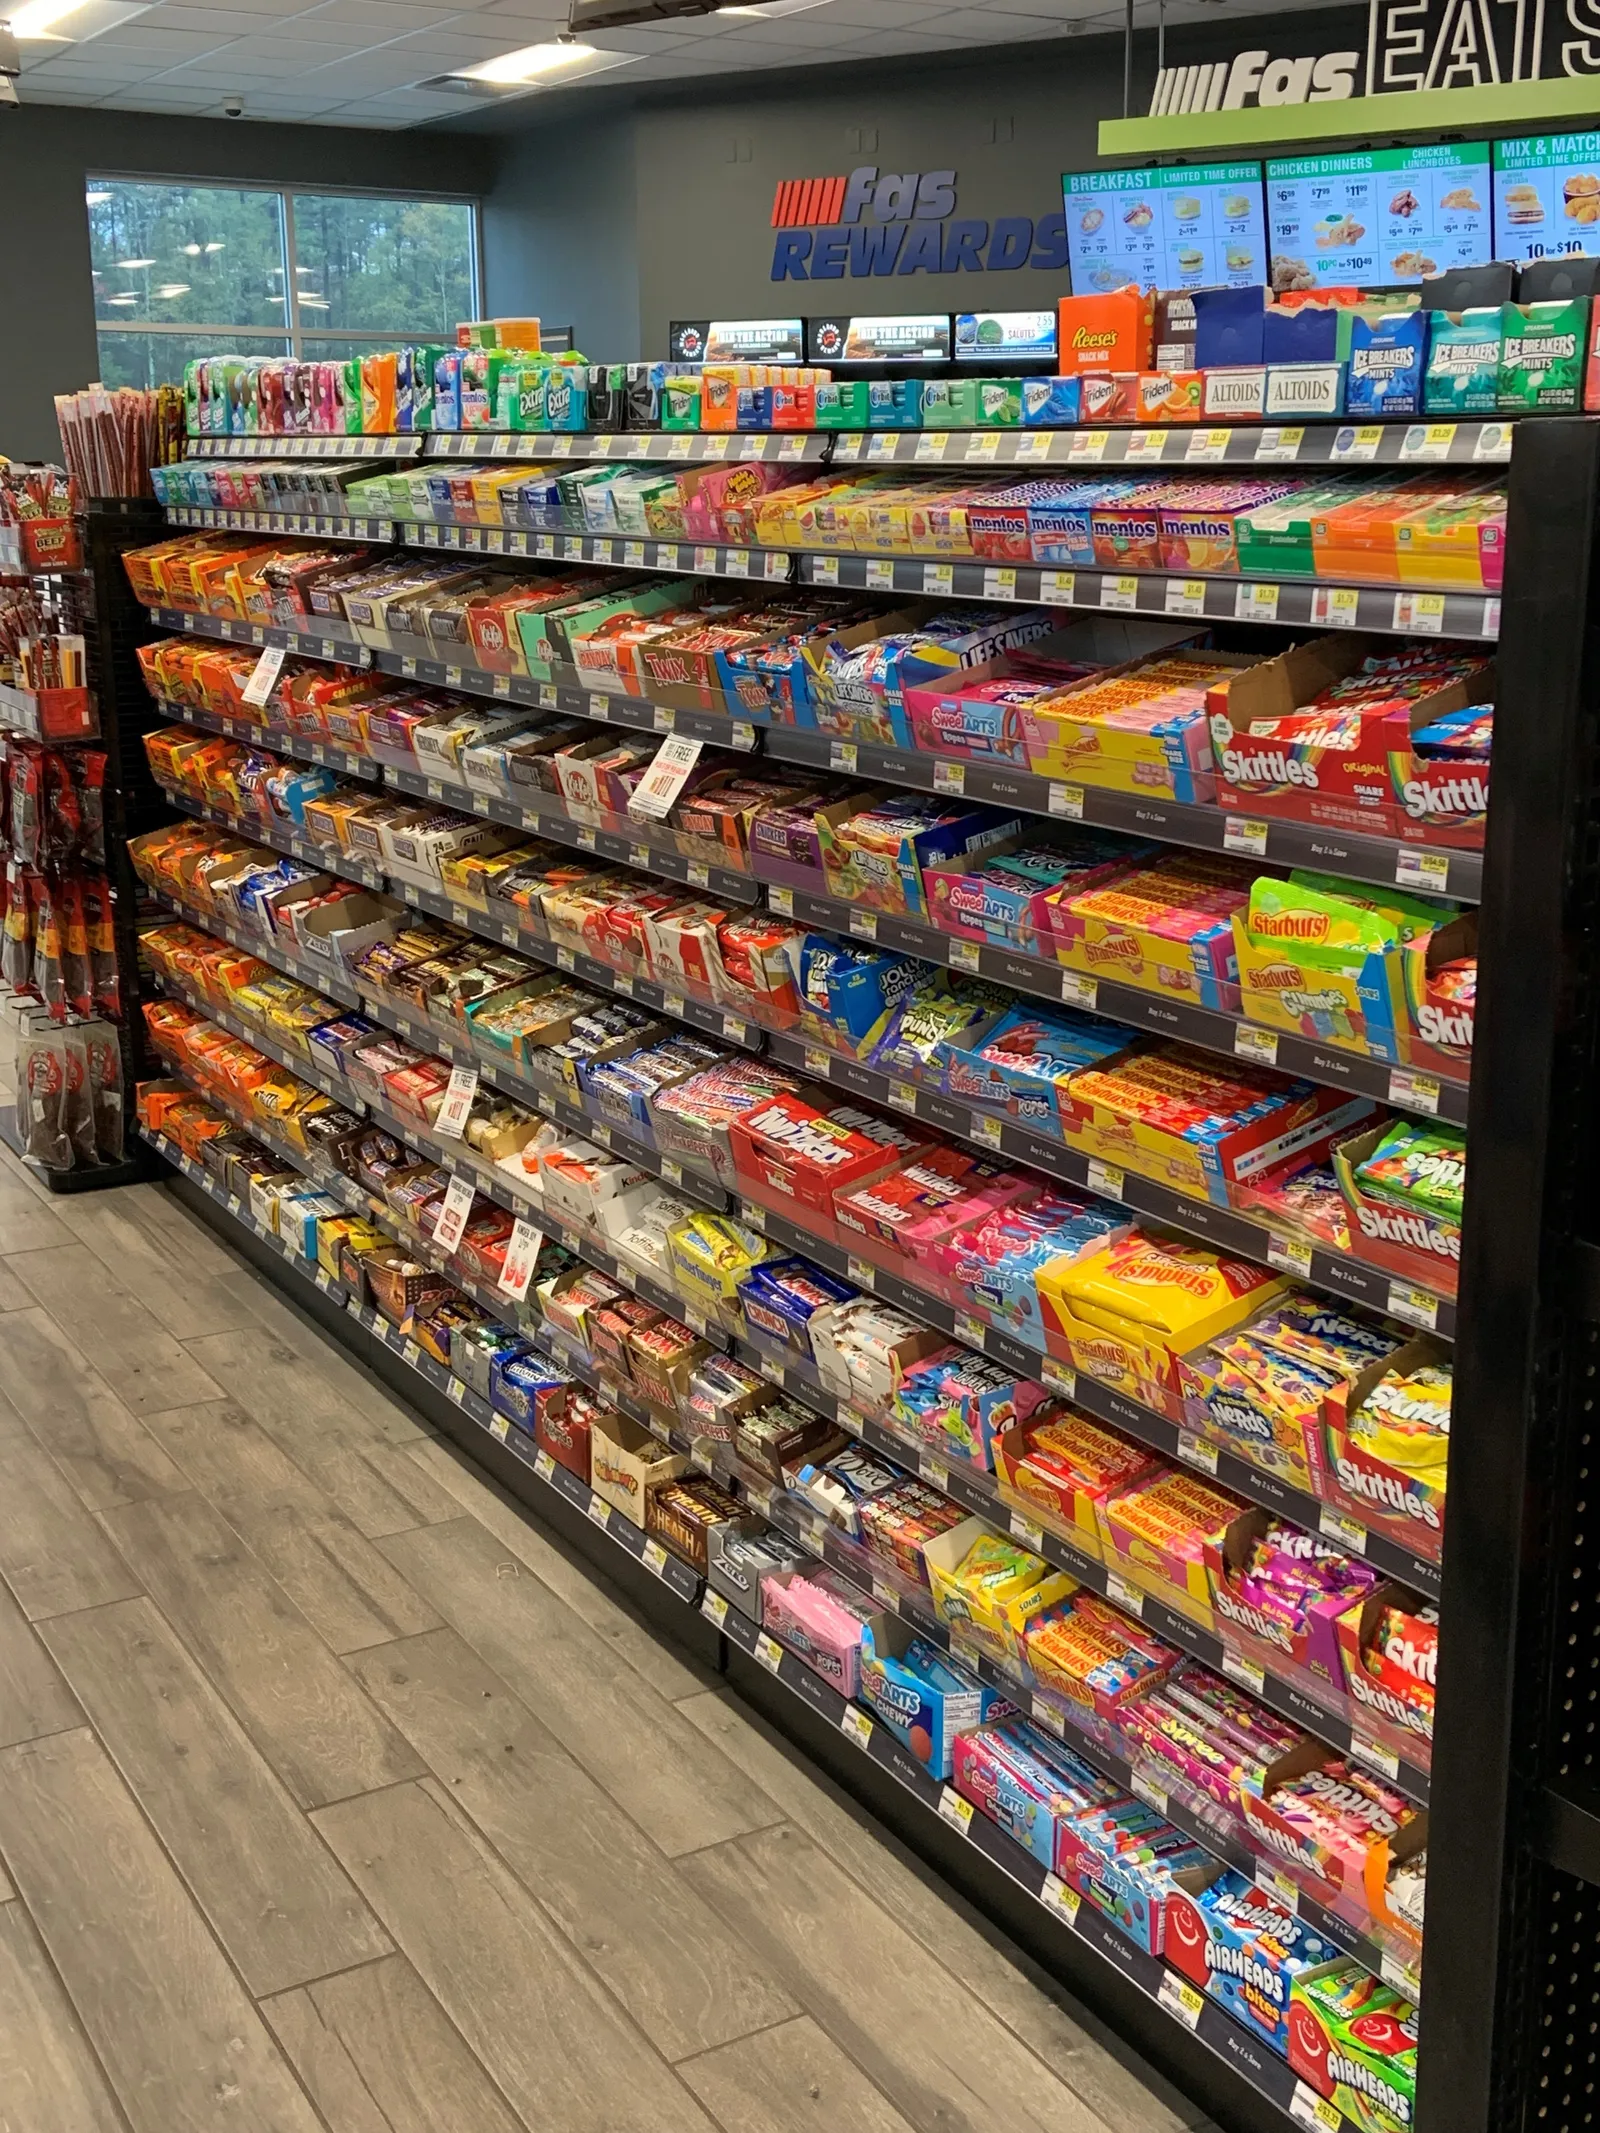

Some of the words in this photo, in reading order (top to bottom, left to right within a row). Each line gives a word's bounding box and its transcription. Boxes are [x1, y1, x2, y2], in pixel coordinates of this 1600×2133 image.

[1223, 50, 1361, 111] fas
[1412, 146, 1450, 158] CHICKEN
[1501, 140, 1532, 158] MIX
[1536, 139, 1547, 154] &
[1269, 161, 1319, 177] CHICKEN
[1321, 156, 1373, 172] DINNERS
[1402, 155, 1462, 169] LUNCHBOXES
[1505, 156, 1543, 168] LIMITED
[1547, 153, 1570, 165] TIME
[1070, 172, 1153, 193] BREAKFAST
[1164, 171, 1200, 183] LIMITED
[1203, 169, 1226, 181] TIME
[1228, 167, 1258, 179] OFFER
[843, 167, 957, 223] fas
[770, 211, 1068, 281] REWARDS
[1072, 326, 1120, 349] Reese's
[1504, 336, 1521, 357] ICE
[1521, 333, 1576, 357] BREAKERS
[1354, 349, 1368, 363] ICE
[1368, 346, 1415, 366] BREAKERS
[1434, 343, 1450, 363] ICE
[1450, 341, 1500, 362] BREAKERS
[1368, 368, 1395, 380] MINTS
[1450, 363, 1479, 375] MINTS
[1522, 357, 1553, 371] MINTS
[981, 390, 1009, 408] Trident
[1023, 387, 1051, 405] Trident
[1084, 381, 1117, 401] Trident
[1140, 379, 1173, 400] Trident
[1211, 382, 1261, 403] ALTOIDS
[1274, 380, 1330, 402] ALTOIDS
[972, 515, 1026, 533] mentos
[1032, 516, 1086, 533] mentos
[1094, 519, 1157, 538] mentos
[1164, 519, 1230, 537] mentos
[36, 537, 65, 549] BEEF
[942, 730, 966, 746] Ropes
[1221, 747, 1320, 789] Skittles
[1253, 911, 1330, 938] Starburst
[880, 957, 921, 991] JOLLY
[1246, 963, 1304, 991] Starburst
[1355, 1204, 1461, 1261] Skittles
[955, 1262, 1014, 1292] SweeTARTS
[837, 1453, 890, 1487] Dove
[1336, 1457, 1441, 1529] Skittles
[655, 1508, 695, 1558] HEATH
[711, 1554, 750, 1591] Zero
[1215, 1590, 1294, 1654] Skittles
[861, 1664, 922, 1716] weeTARTS
[875, 1700, 913, 1729] CHEWY
[1350, 1673, 1434, 1741] Skittles
[971, 1770, 1025, 1818] SweeTARTS
[1075, 1852, 1130, 1900] SweeTARTS
[1216, 1891, 1302, 1945] AIRHEADS
[1204, 1937, 1284, 2003] AIRHEADS
[1243, 1980, 1281, 2024] bites
[1327, 2055, 1411, 2123] AIRHEADS
